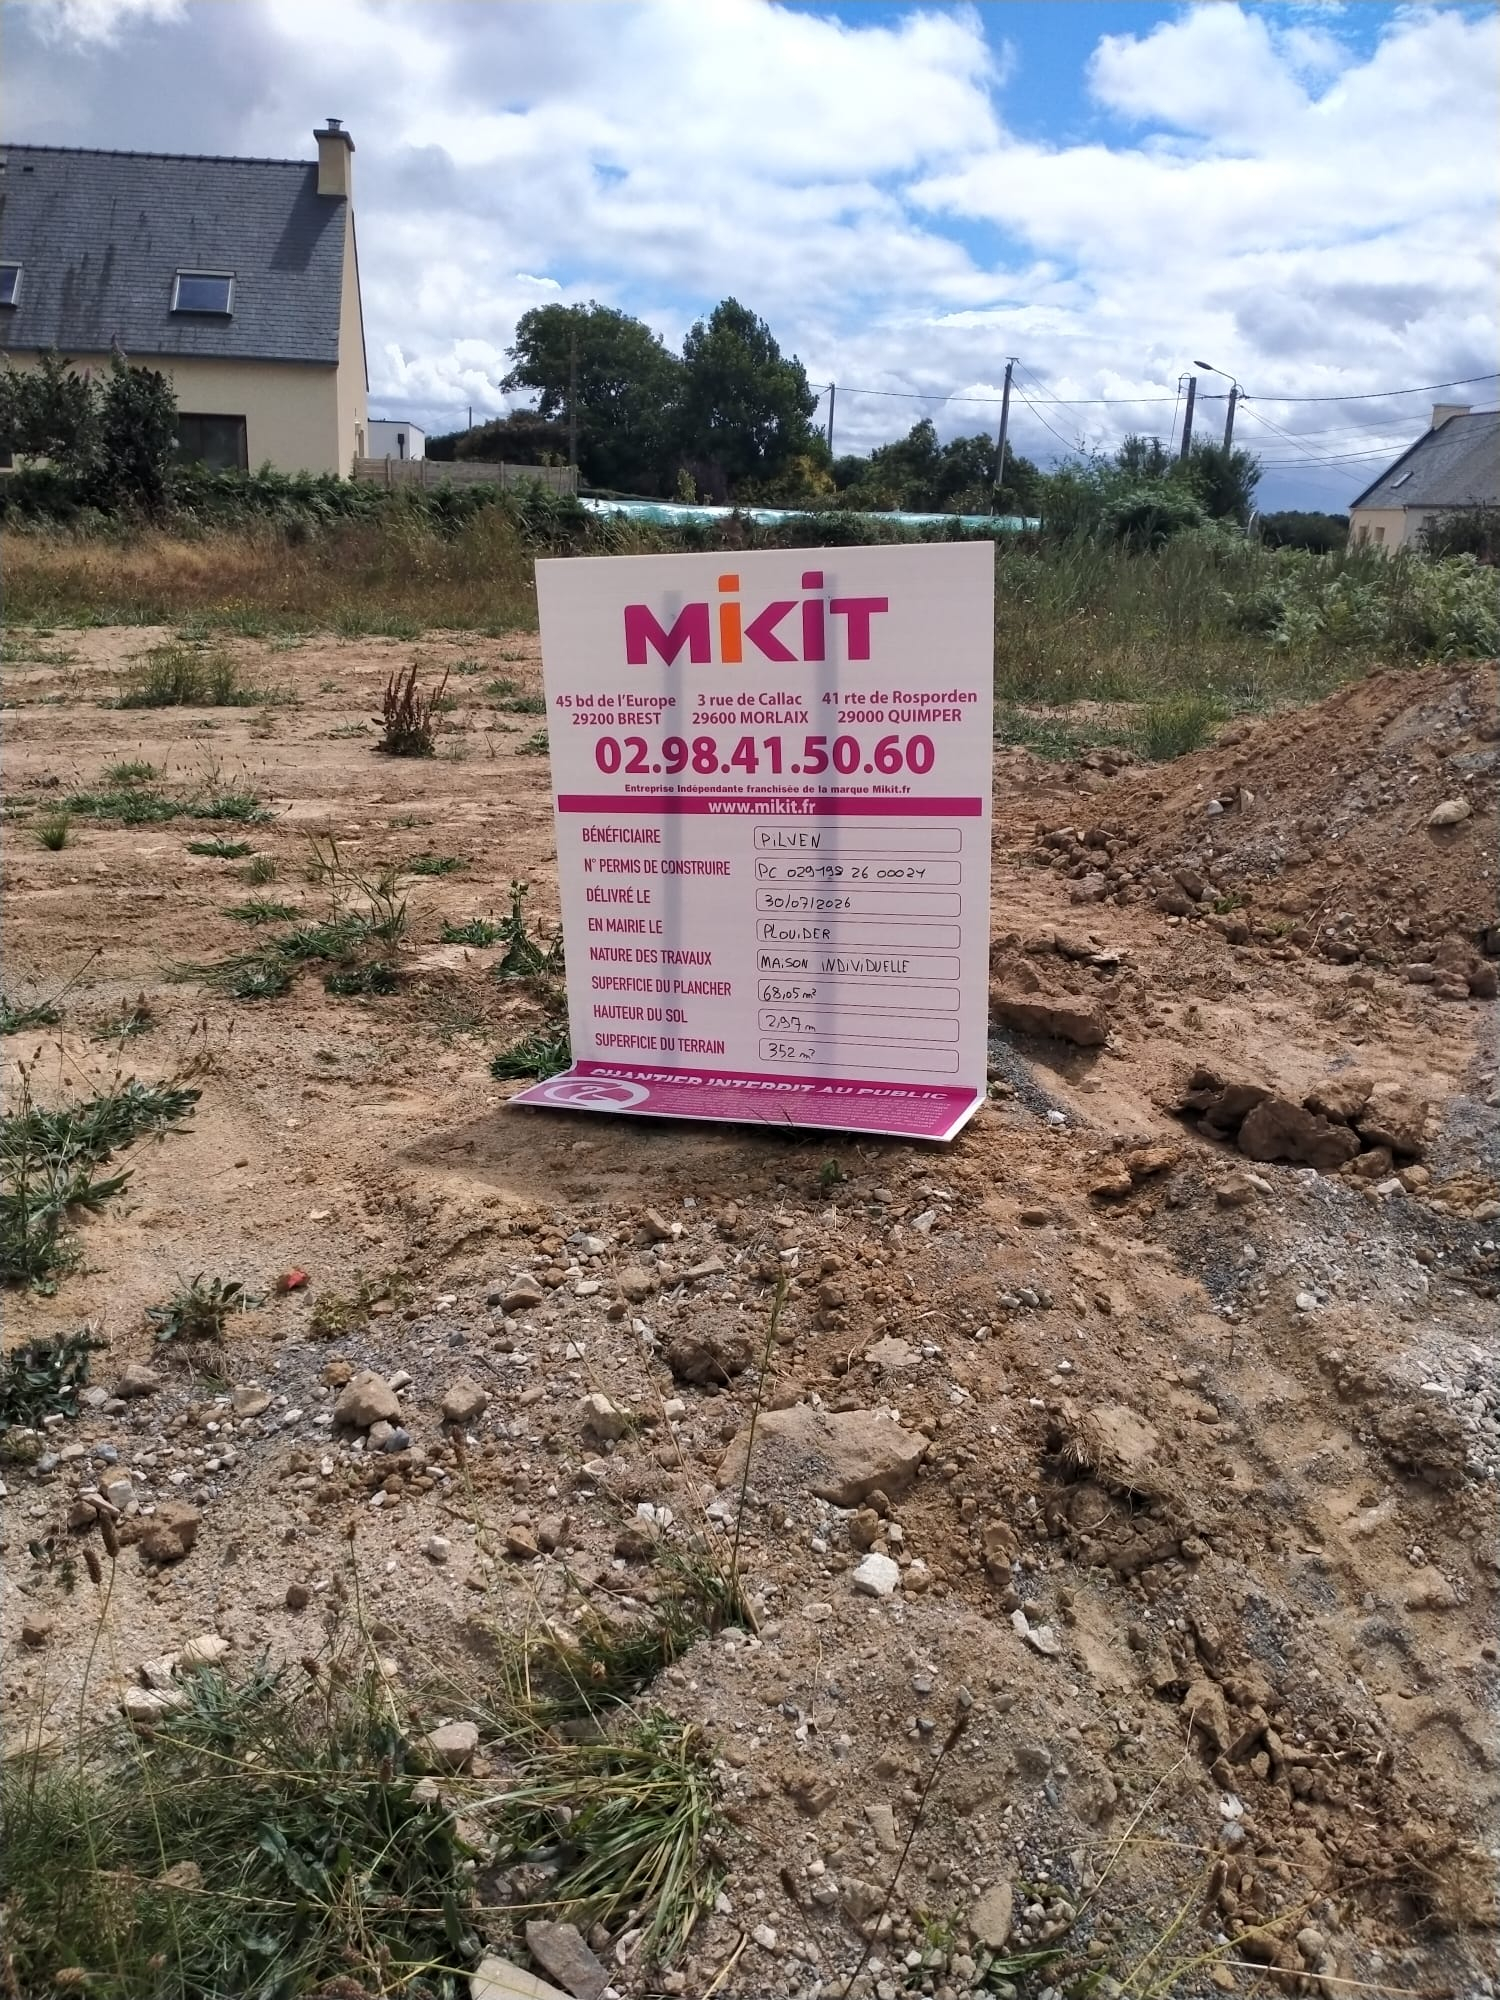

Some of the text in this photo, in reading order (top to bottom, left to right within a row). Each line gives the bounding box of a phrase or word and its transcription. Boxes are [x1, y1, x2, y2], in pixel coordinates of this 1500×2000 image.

[556, 694, 676, 709] 45 bd de l'Europe
[697, 692, 802, 706] 3 rue de Callac
[822, 689, 977, 706] 41 rte de Rosporden
[572, 712, 661, 725] 29200 BREST
[692, 711, 809, 725] 29600 MORLAIX
[837, 709, 962, 724] 29000 QUIMPER
[595, 734, 935, 774] 02.98.41.50.60
[625, 784, 911, 795] Entreprise Indépendante franchisée de la marque Mikit.fr
[708, 798, 816, 814] www.mikit.fr
[582, 825, 661, 844] BÉNÉFICIAIRE
[584, 858, 731, 876] N° PERMIS DE CONSTRUIRE
[758, 863, 777, 878] PC
[851, 866, 869, 879] 26
[586, 885, 651, 904] DÉLIVRÉ LE
[764, 894, 851, 910] 30/07/2026
[588, 917, 663, 934] EN MAIRIE LE
[590, 947, 712, 966] NATURE DES TRAVAUX
[592, 976, 732, 996] SUPERFICIE DU PLANCHER
[763, 985, 801, 1001] 68,05
[593, 1004, 688, 1023] HAUTEUR DU SOL
[765, 1015, 801, 1032] 2,97
[595, 1033, 725, 1055] SUPERFICIE DU TERRAIN
[768, 1043, 796, 1059] 352
[816, 1086, 853, 1094] AU
[856, 1088, 949, 1100] PUBLIC
